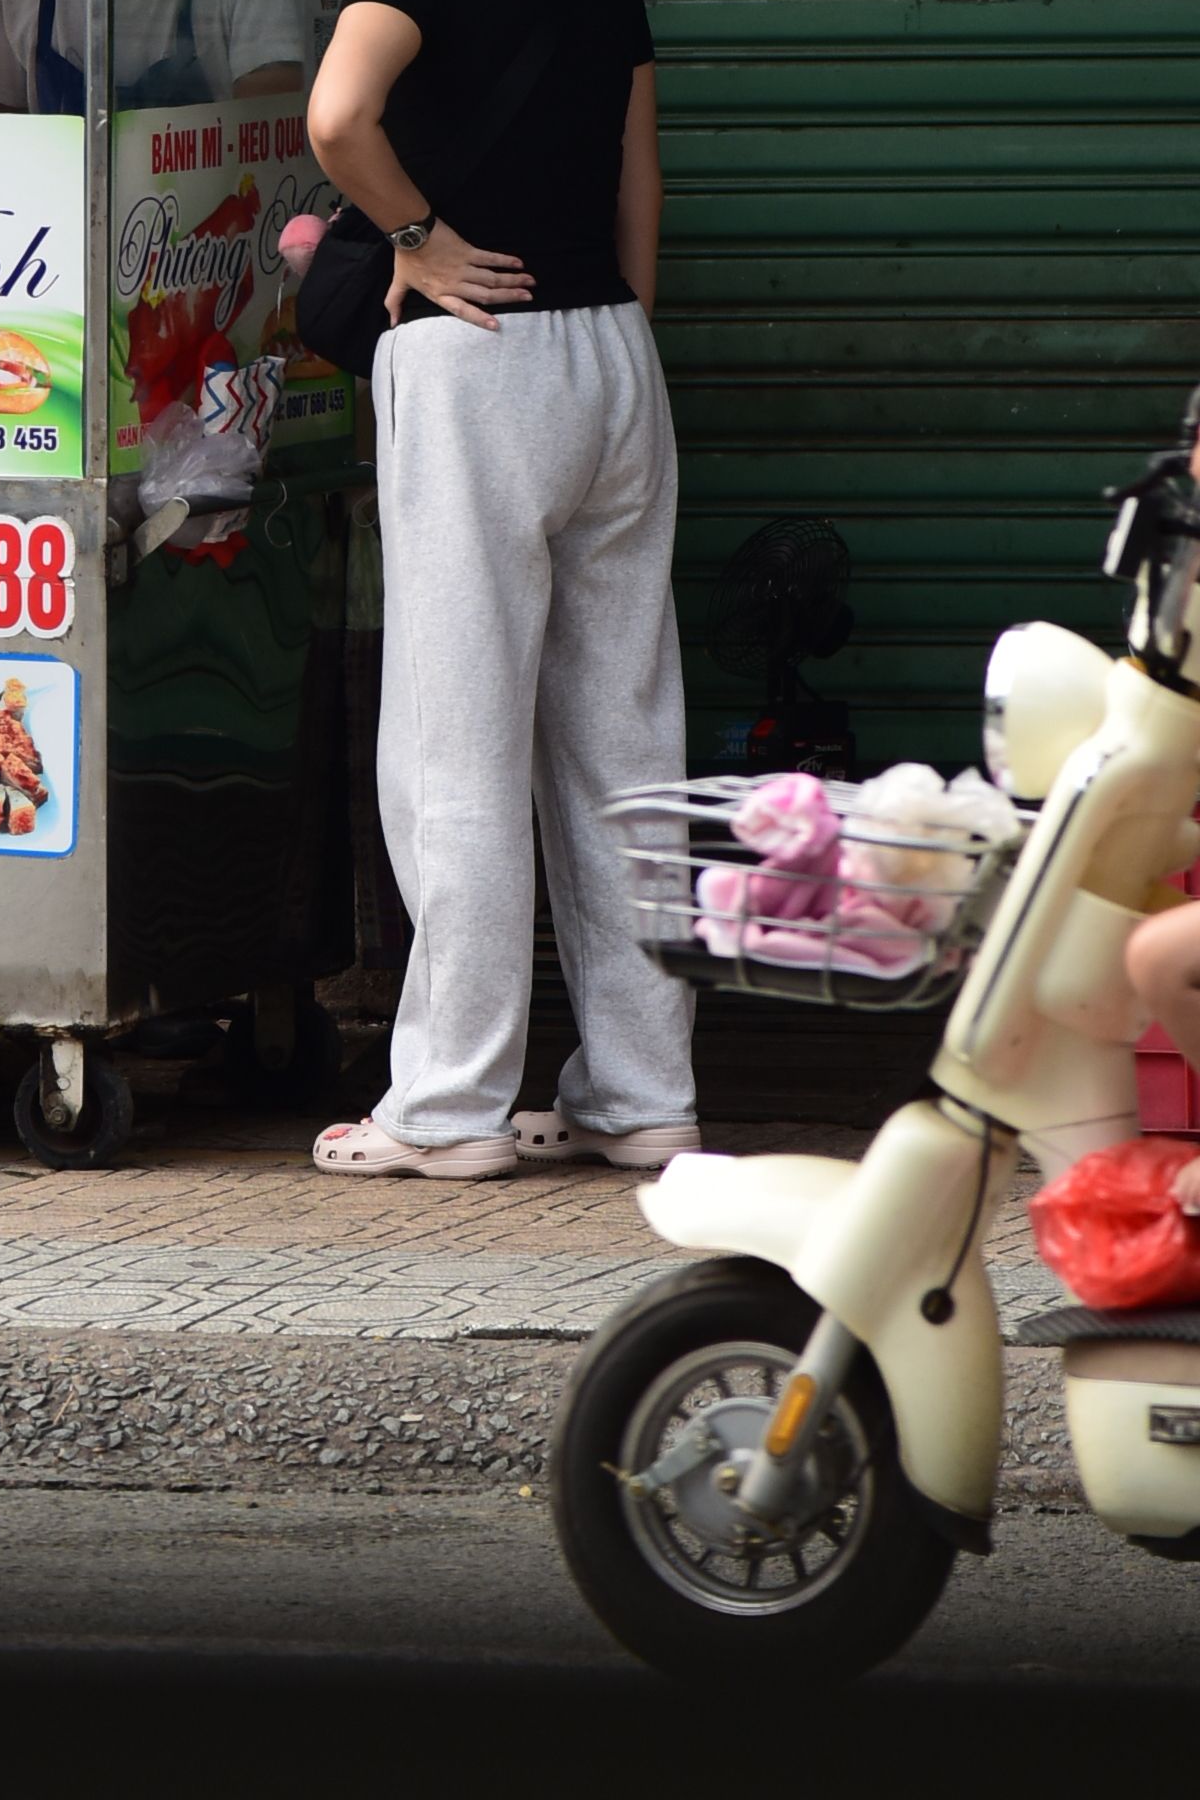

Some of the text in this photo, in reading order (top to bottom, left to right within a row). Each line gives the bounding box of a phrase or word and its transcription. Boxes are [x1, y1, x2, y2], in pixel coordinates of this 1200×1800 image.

[152, 123, 196, 175] BÁNH
[202, 117, 222, 169] MÌ
[239, 120, 269, 164] HEO
[117, 195, 251, 325] Phương
[13, 427, 58, 451] 455
